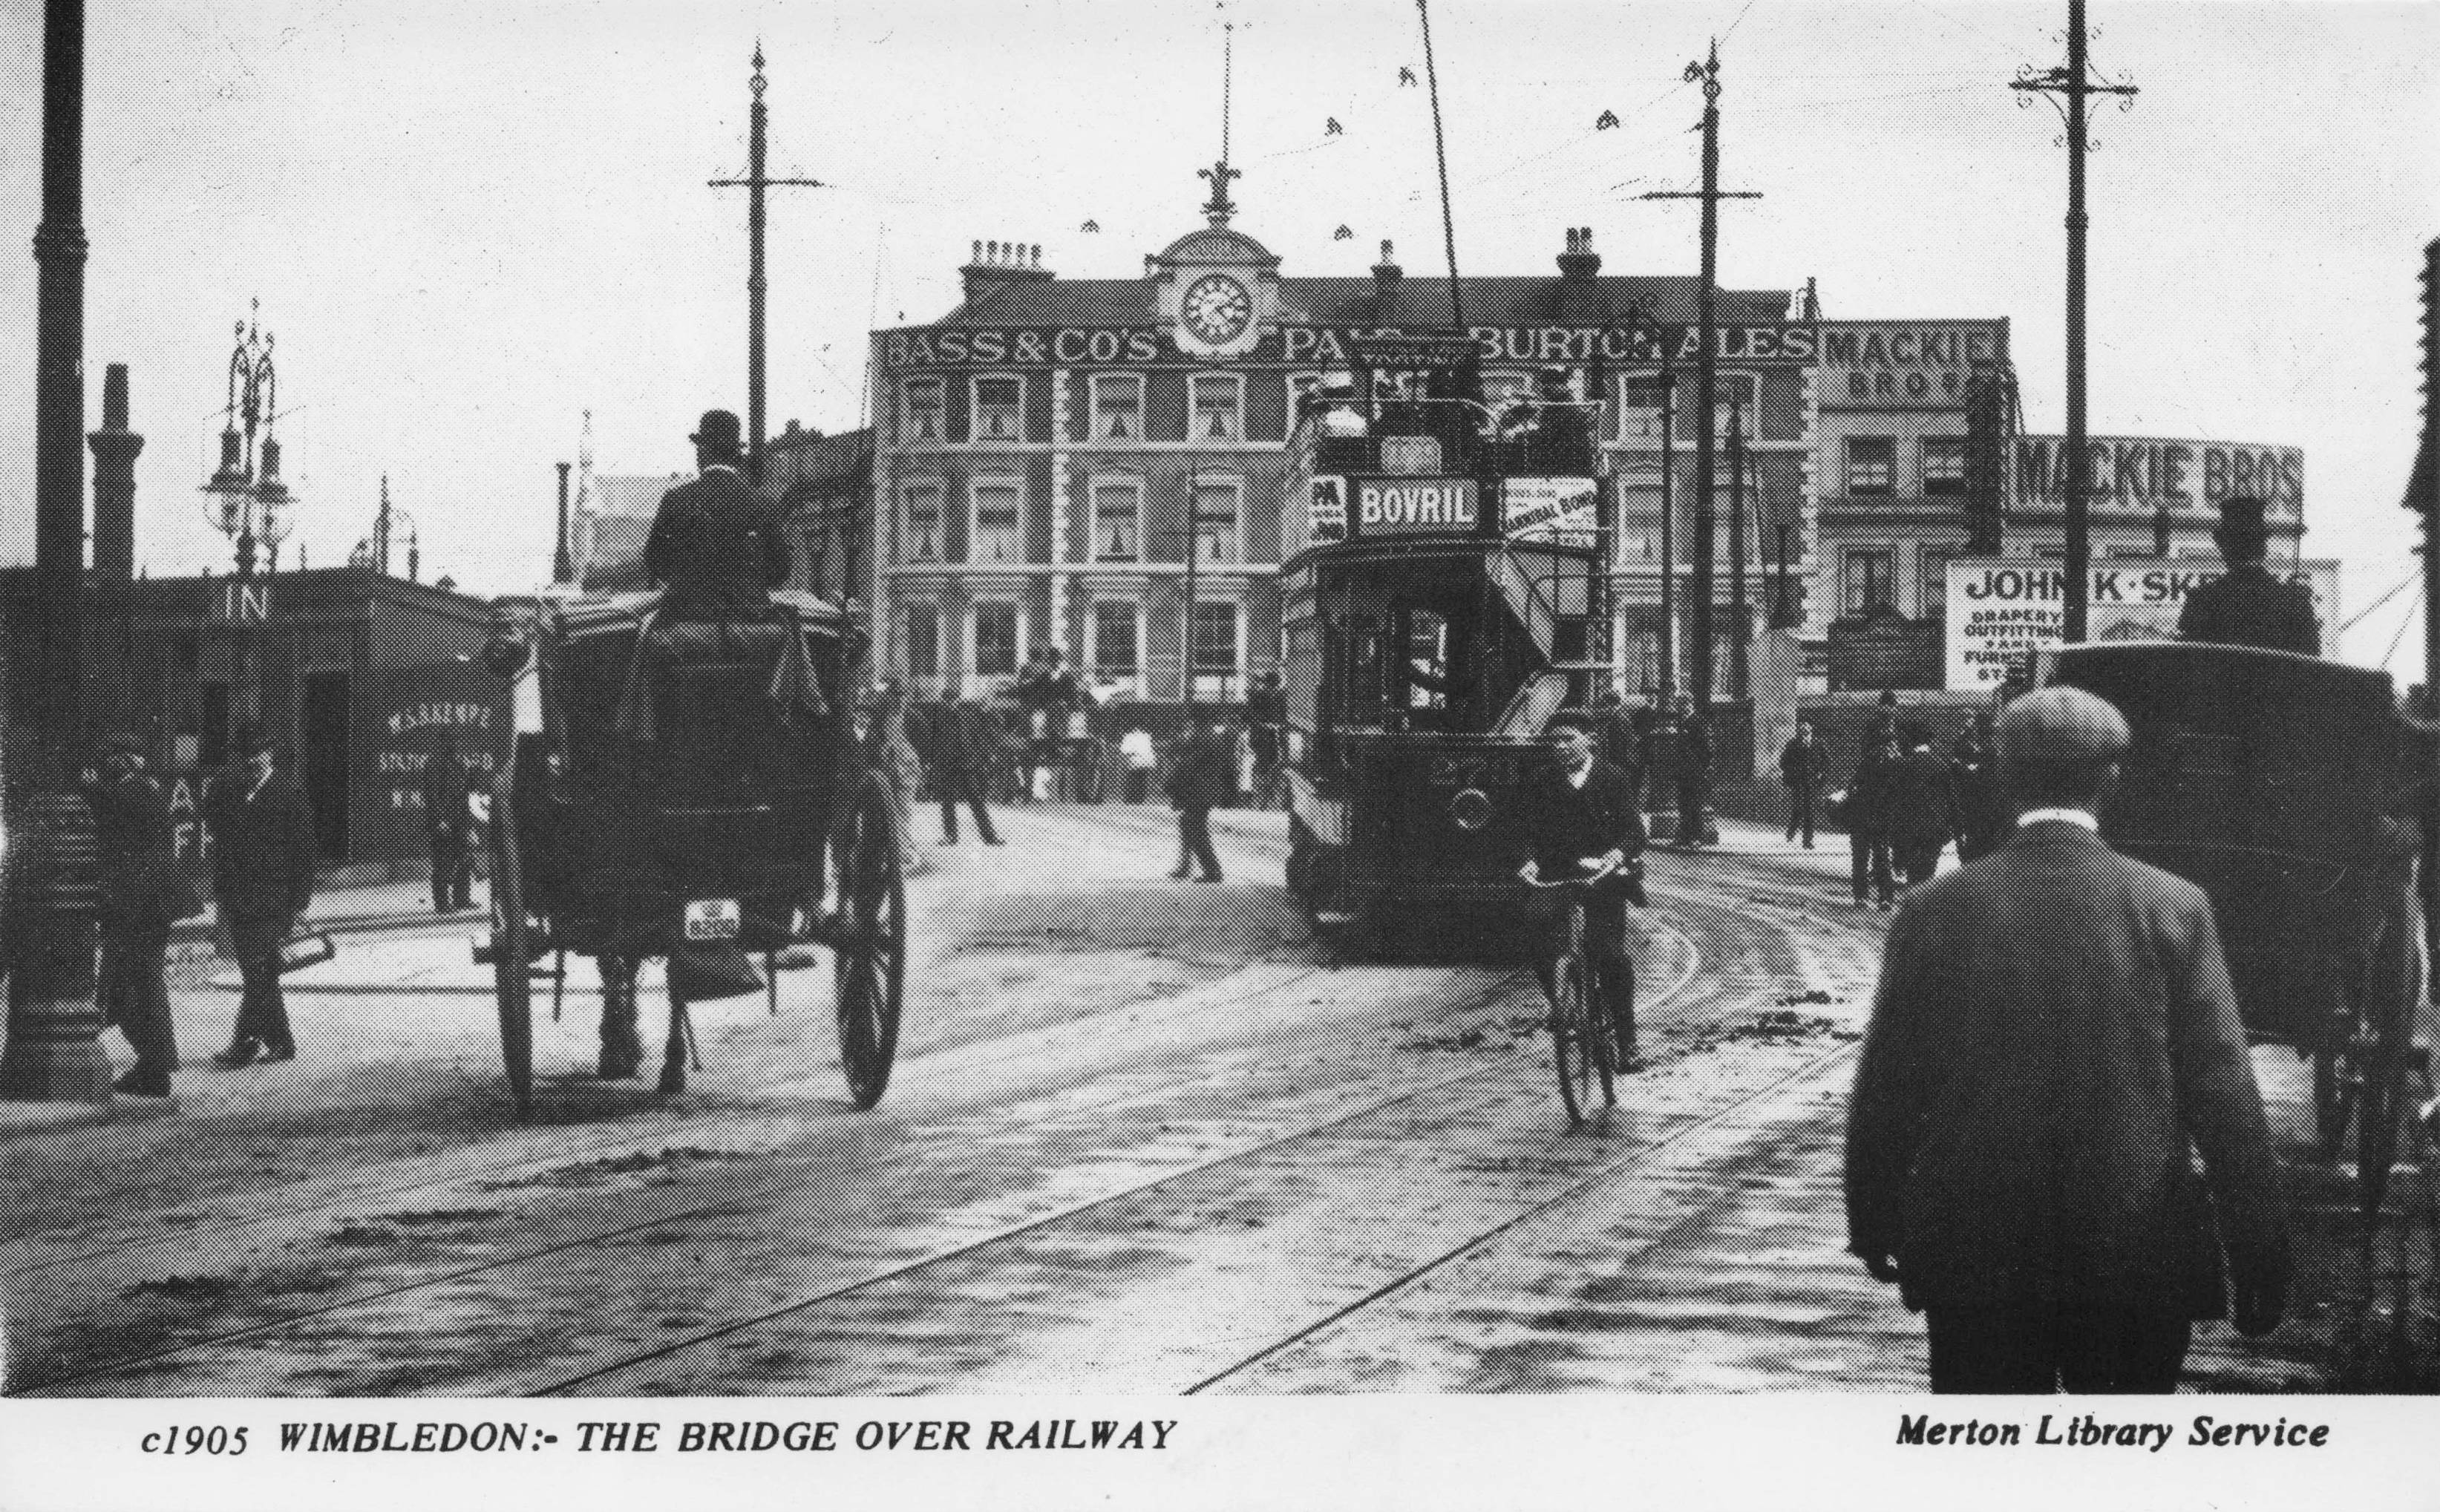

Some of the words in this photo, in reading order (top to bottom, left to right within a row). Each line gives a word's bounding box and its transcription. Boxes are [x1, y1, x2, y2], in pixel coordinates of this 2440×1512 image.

[1014, 331, 1047, 361] &
[1825, 331, 1989, 371] MACKIE
[2015, 441, 2194, 511] MACKIE
[1361, 487, 1475, 524] BOVRIL
[225, 585, 269, 619] IN
[2094, 570, 2122, 602] K
[1971, 609, 2062, 625] DRAPERY
